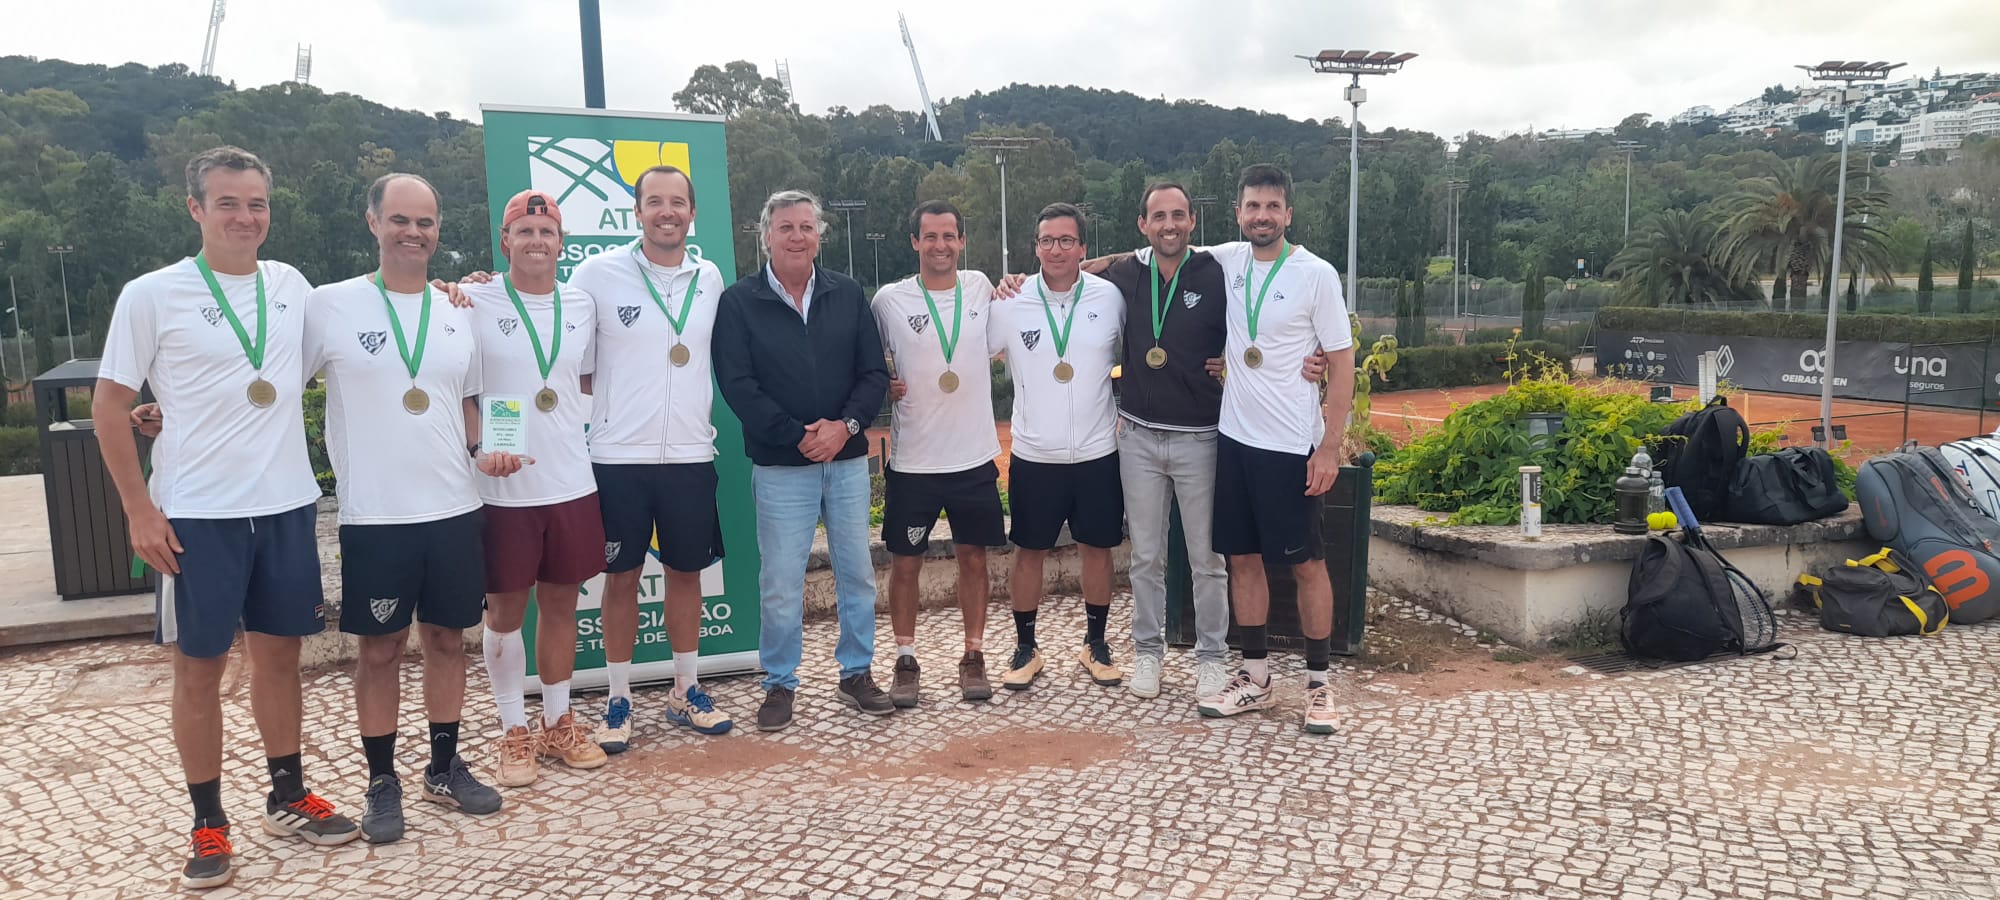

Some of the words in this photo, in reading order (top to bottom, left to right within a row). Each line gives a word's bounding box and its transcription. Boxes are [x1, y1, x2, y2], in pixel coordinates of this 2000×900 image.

[1894, 355, 1947, 377] una
[1782, 374, 1818, 385] OEIRAS
[1819, 377, 1848, 387] OEN
[1909, 381, 1945, 391] seguros
[643, 632, 667, 645] DE
